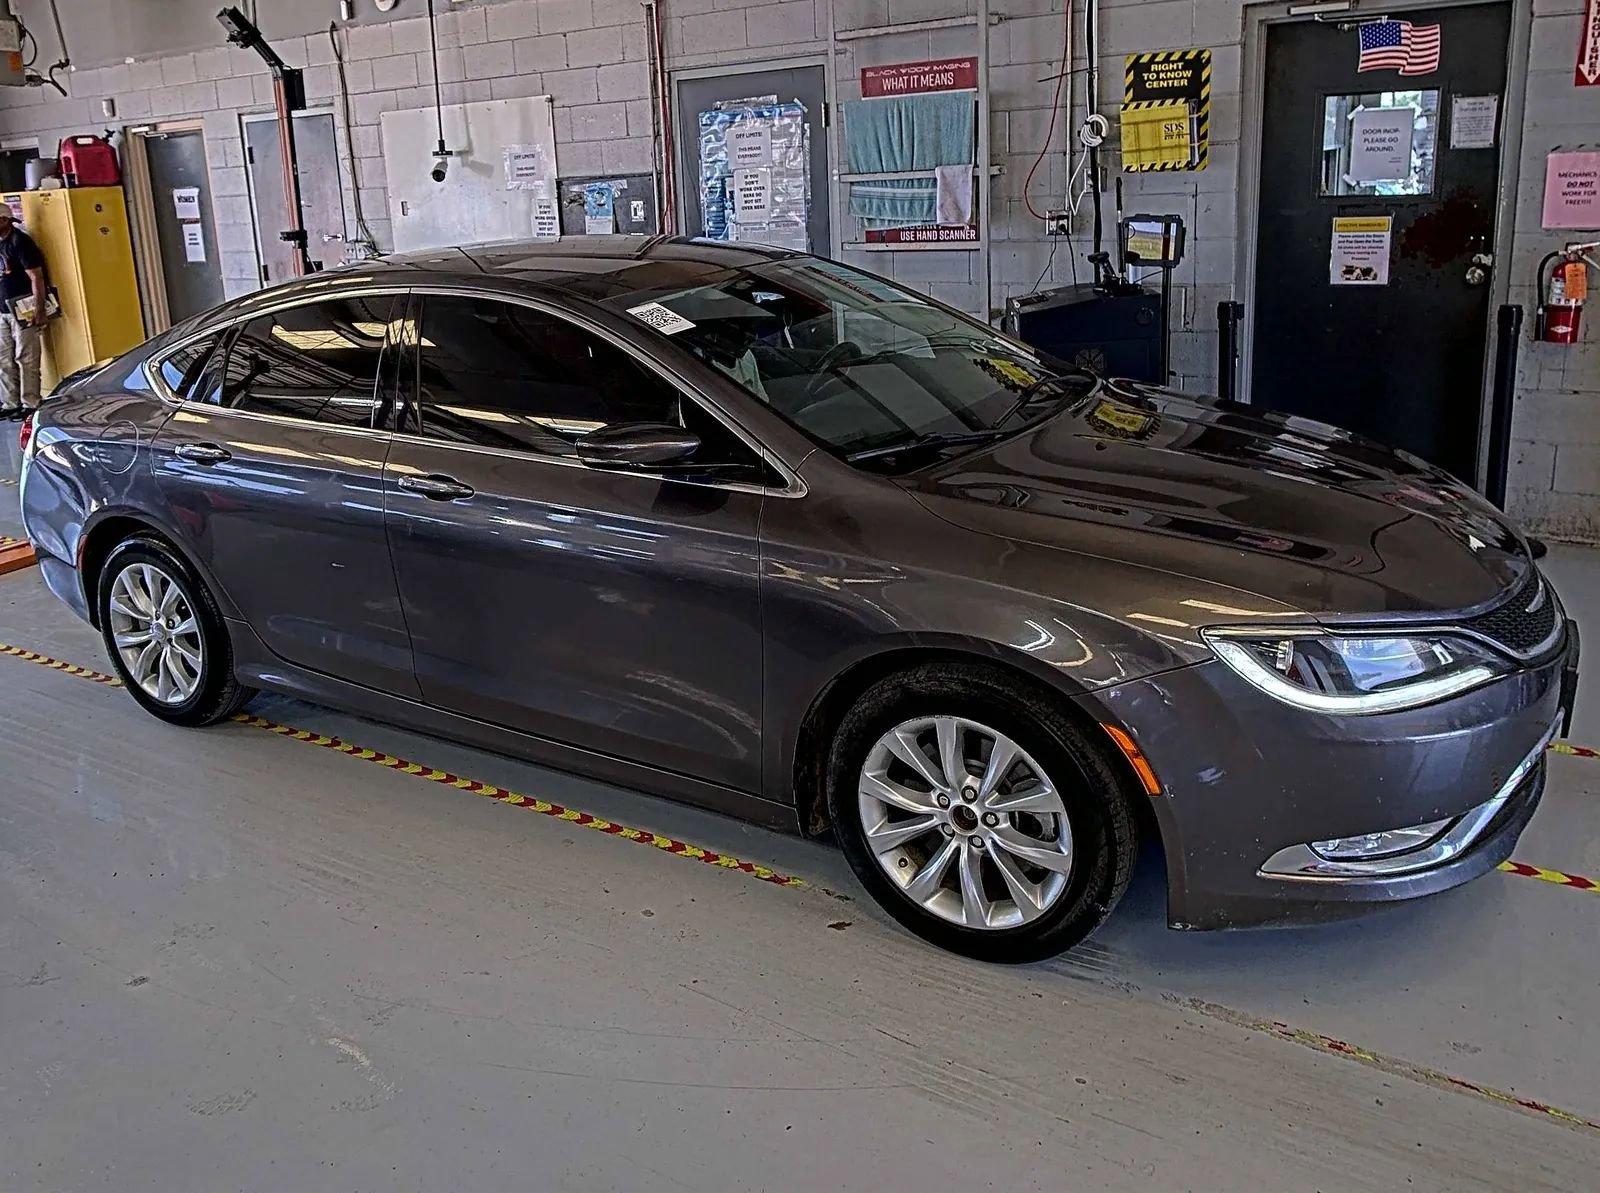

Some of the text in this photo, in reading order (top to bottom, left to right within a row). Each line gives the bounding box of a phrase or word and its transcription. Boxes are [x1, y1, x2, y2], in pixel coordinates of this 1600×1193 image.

[1151, 62, 1184, 71] RIGHT
[1160, 70, 1193, 79] KNOW
[882, 72, 954, 91] WHAT IT MEANS
[1146, 79, 1188, 89] CENTER
[1164, 122, 1184, 132] SDS
[1579, 180, 1594, 188] NOT
[900, 229, 976, 241] USE HAND SCANNER
